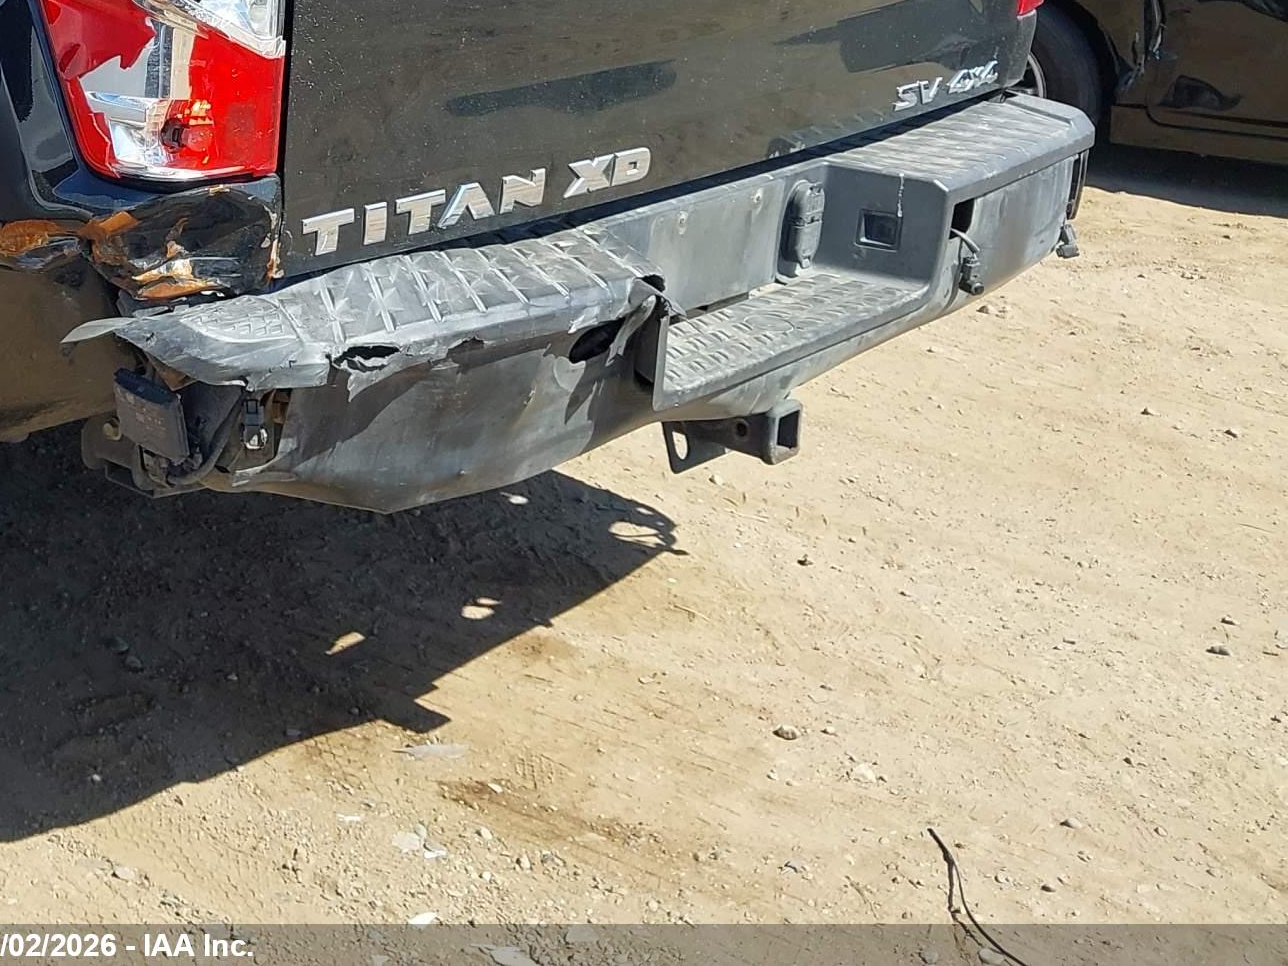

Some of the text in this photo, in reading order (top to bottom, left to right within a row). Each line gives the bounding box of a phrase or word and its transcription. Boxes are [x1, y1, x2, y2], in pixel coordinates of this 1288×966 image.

[892, 76, 943, 111] SV
[302, 146, 652, 256] TITAN XD
